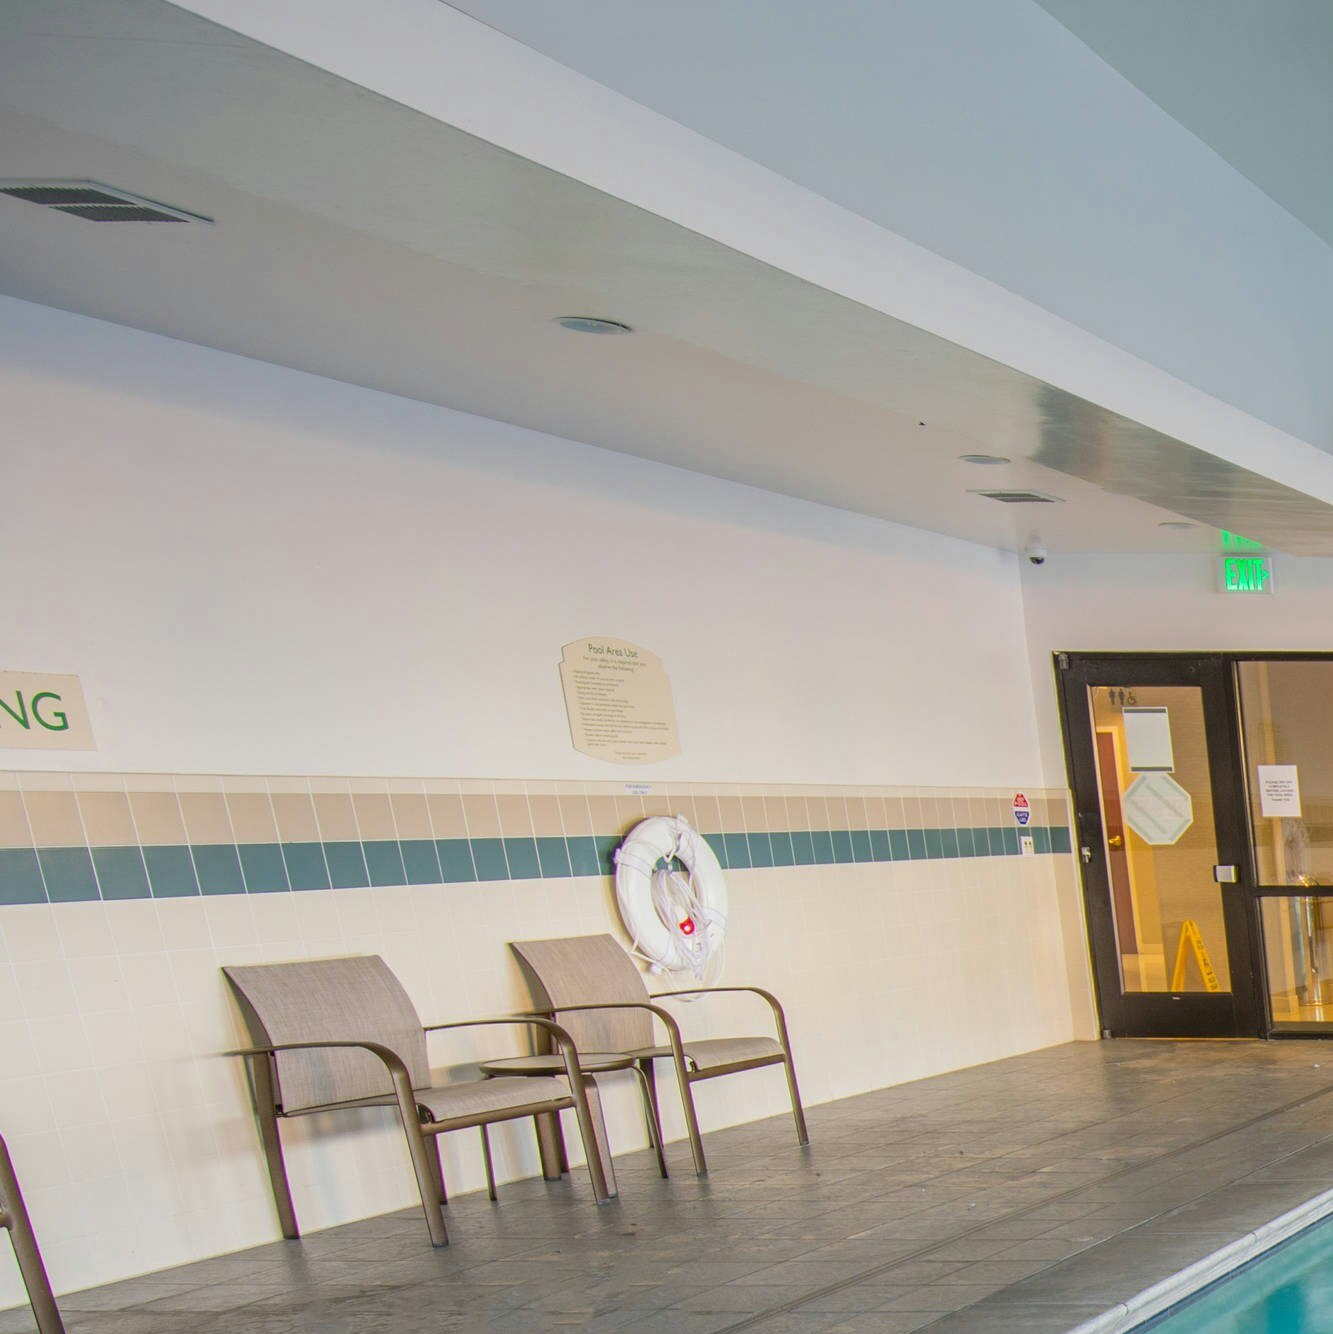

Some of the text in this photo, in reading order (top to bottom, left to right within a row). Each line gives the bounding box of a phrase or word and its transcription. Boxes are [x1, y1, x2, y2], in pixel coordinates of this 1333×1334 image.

[1225, 558, 1264, 591] EXIT
[588, 643, 638, 658] Pool Area Use
